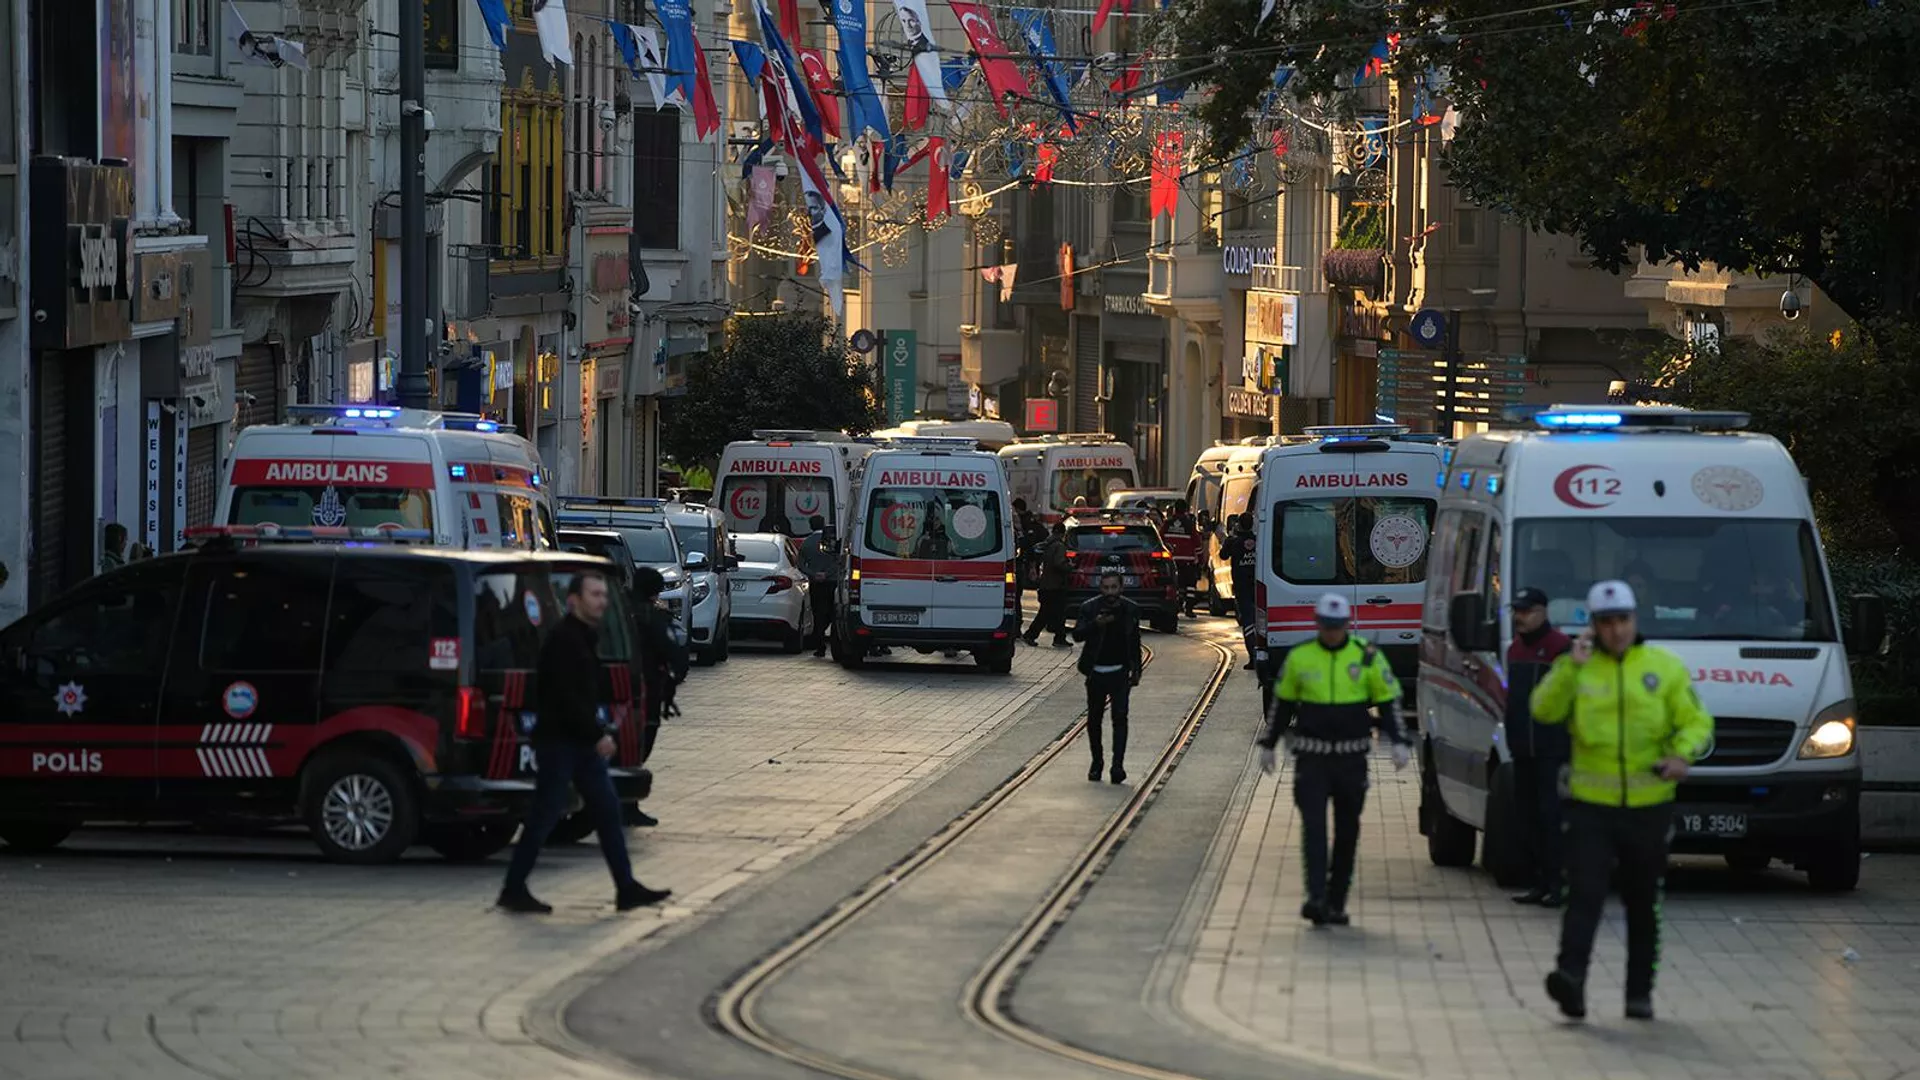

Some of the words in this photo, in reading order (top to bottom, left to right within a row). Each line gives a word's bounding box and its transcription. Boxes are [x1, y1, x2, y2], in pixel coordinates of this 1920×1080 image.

[1223, 245, 1254, 274] GOLDEN
[1256, 246, 1276, 275] ROSE
[1229, 391, 1251, 416] GOLDEN
[1252, 394, 1267, 417] ROSE
[1034, 405, 1049, 424] E
[176, 410, 185, 507] CHANGE
[730, 460, 822, 474] AMBULANS
[1057, 457, 1123, 468] AMBULANS
[265, 463, 389, 483] AMBULANS
[879, 471, 987, 488] AMBULANS
[1296, 473, 1408, 488] AMBULANS
[1569, 477, 1622, 496] 112
[737, 495, 760, 510] 112
[890, 514, 915, 530] 112
[434, 640, 457, 657] 112
[32, 748, 103, 772] POLİS
[1708, 814, 1744, 832] 3504
